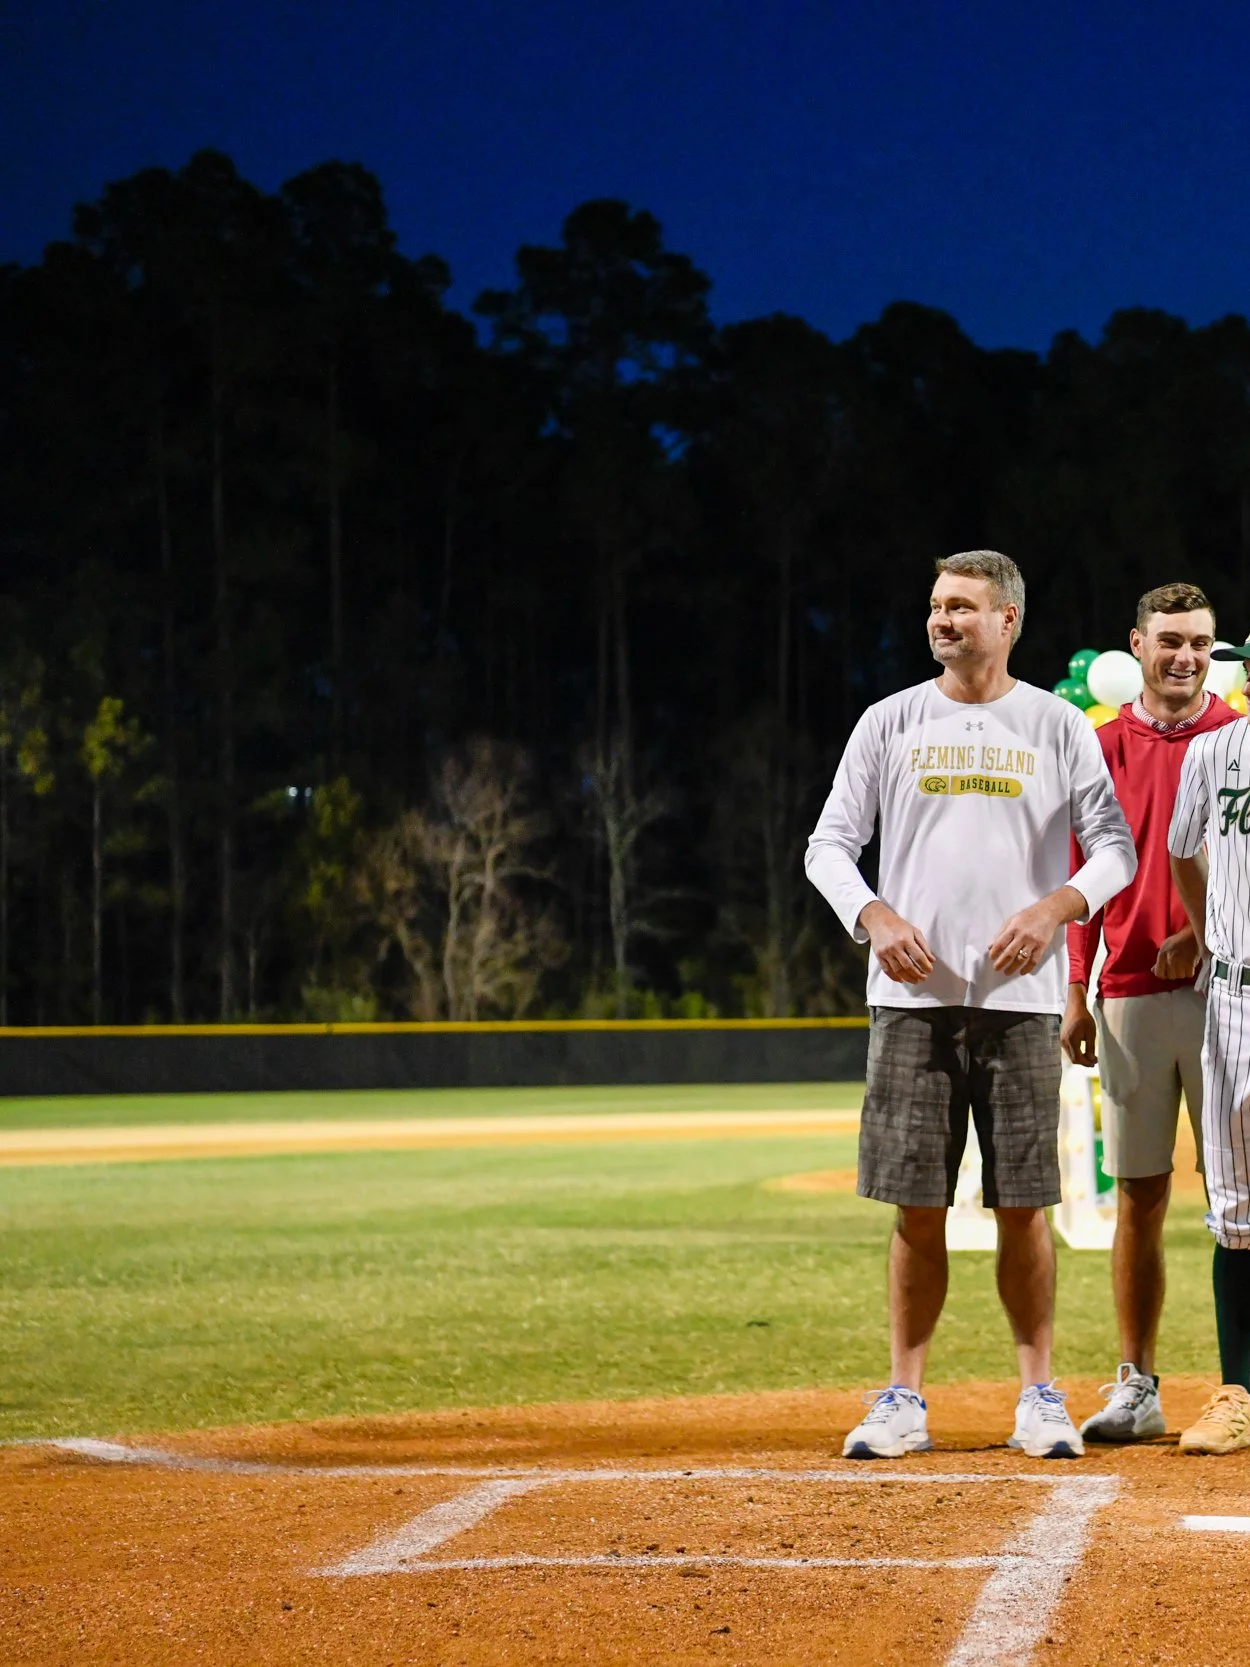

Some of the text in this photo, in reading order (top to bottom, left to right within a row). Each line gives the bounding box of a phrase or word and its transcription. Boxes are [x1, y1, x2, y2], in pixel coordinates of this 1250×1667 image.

[911, 745, 1035, 775] FLEMING ISLAND
[960, 778, 1010, 793] BASEBALL
